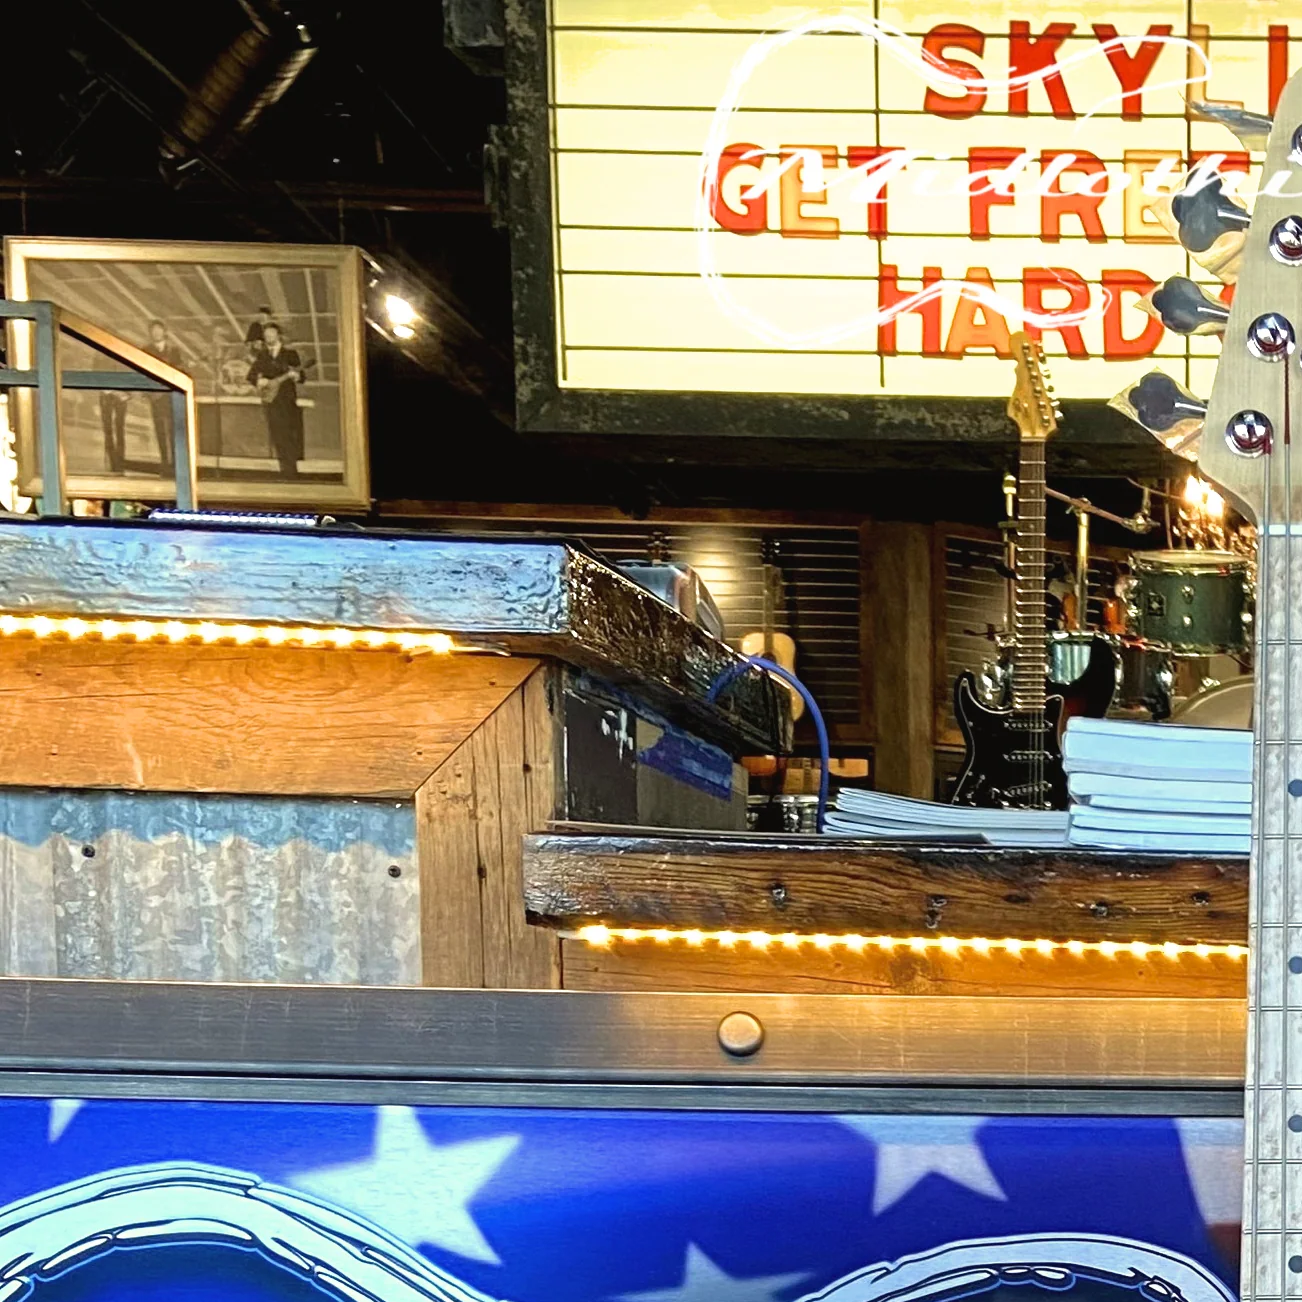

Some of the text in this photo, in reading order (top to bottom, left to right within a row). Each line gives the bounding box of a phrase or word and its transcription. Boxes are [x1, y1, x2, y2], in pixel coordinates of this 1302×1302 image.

[922, 20, 1175, 121] SKY
[708, 142, 906, 241] GET
[968, 147, 1251, 245] FRE
[878, 263, 1166, 362] HARD
